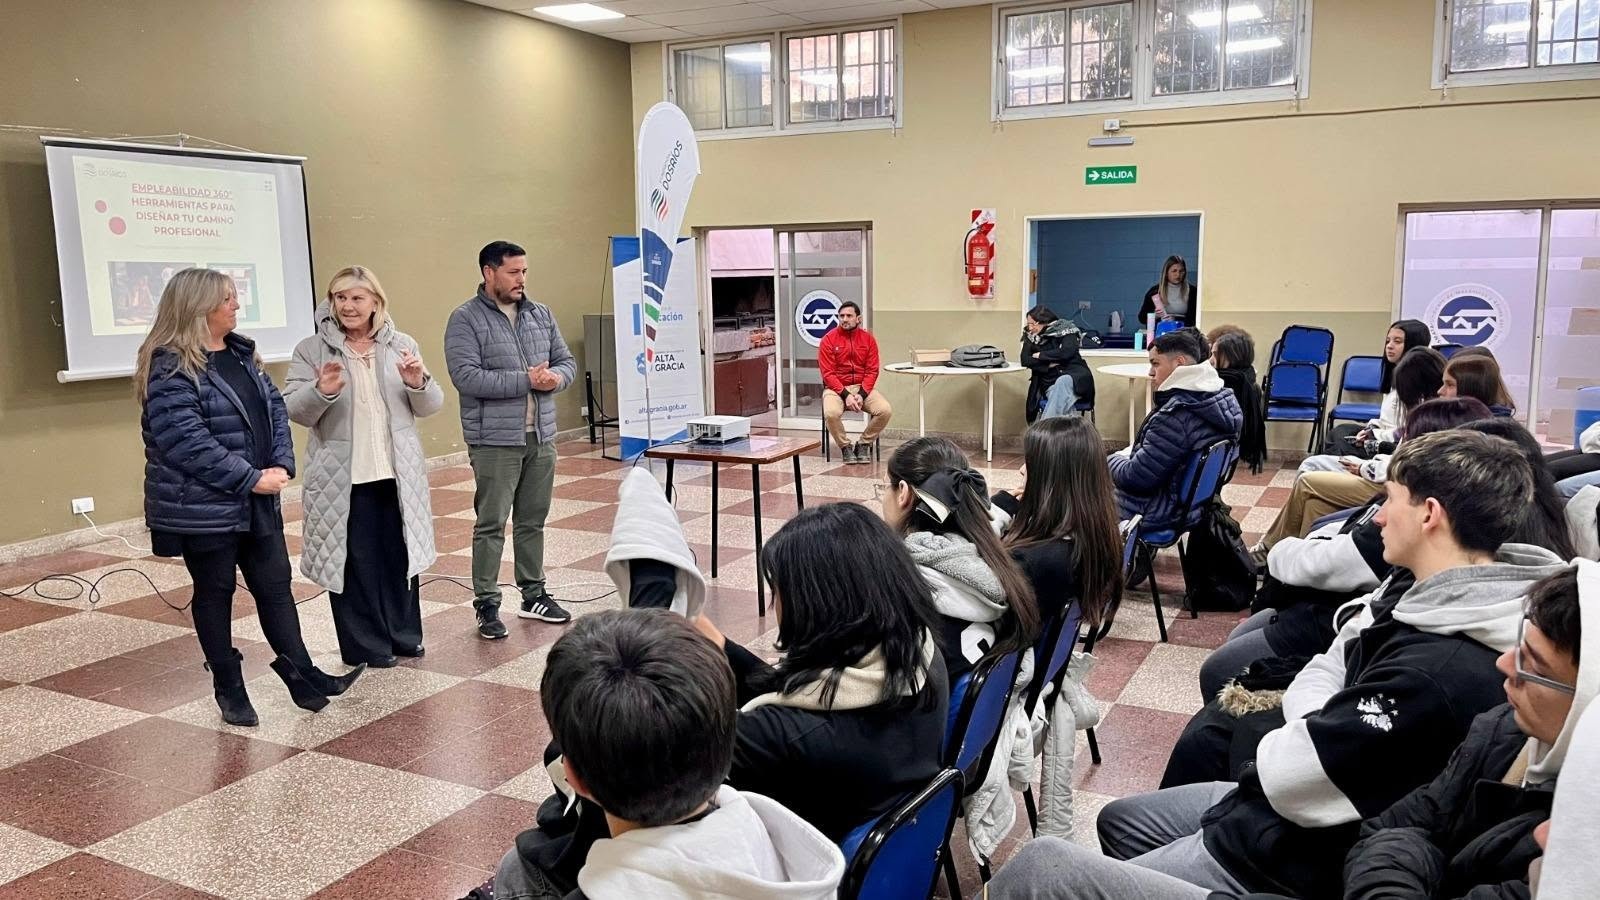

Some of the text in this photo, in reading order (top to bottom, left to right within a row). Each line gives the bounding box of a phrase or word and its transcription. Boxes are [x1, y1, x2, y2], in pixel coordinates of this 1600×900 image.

[1101, 171, 1133, 179] SALIDA
[131, 183, 211, 198] EMPLEABILIDAD
[131, 197, 236, 212] HERRAMIENTAS PARA
[136, 211, 234, 225] DISEÑAR TU CAMINO
[154, 226, 221, 237] PROFESIONAL
[655, 354, 675, 363] ALTA
[655, 362, 685, 372] GRACIA
